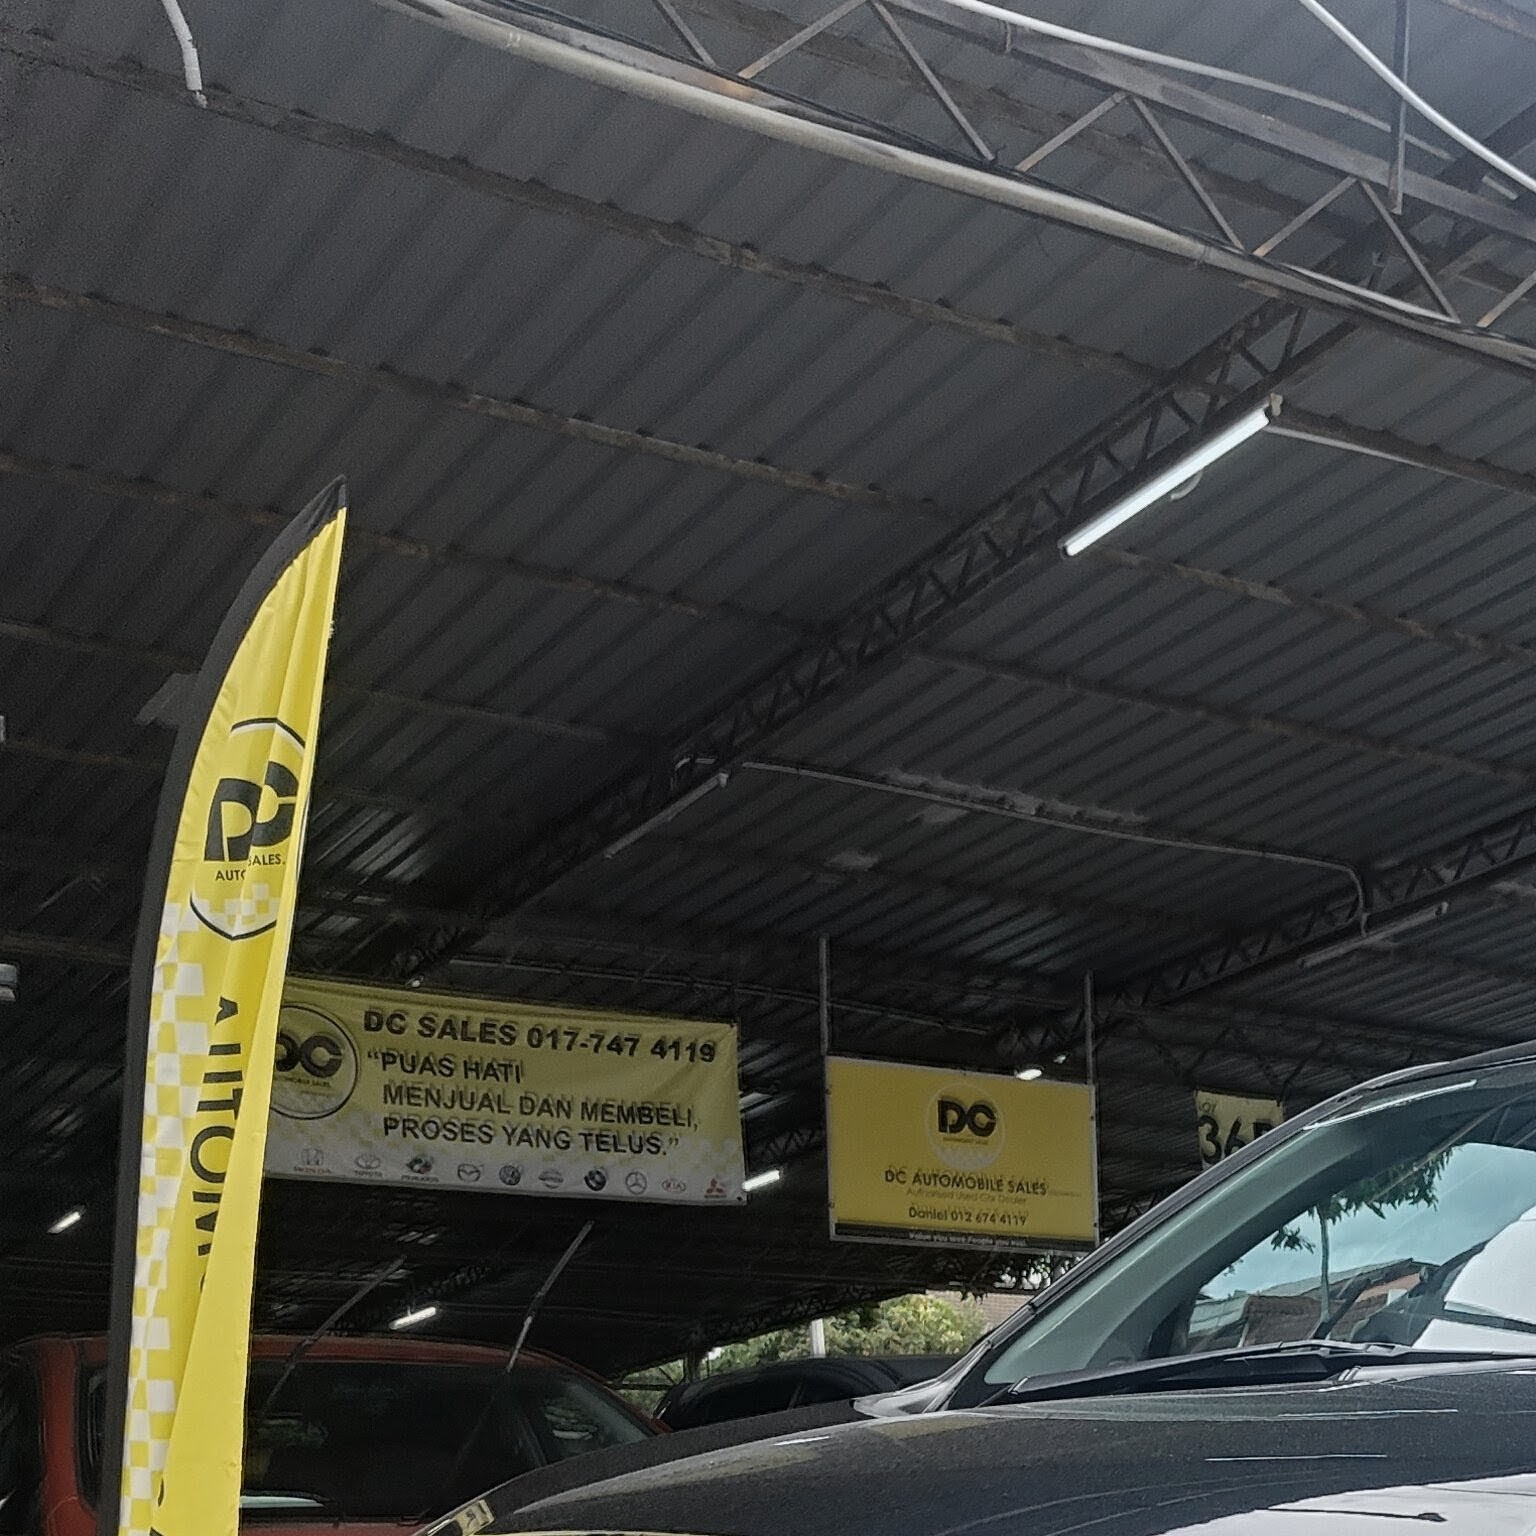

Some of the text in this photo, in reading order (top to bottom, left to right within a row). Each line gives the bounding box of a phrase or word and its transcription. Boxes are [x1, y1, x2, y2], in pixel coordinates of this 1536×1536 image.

[204, 761, 300, 861] DC
[364, 1010, 716, 1063] DC SALES 017-747 4119
[463, 1058, 522, 1084] HATI
[383, 1083, 698, 1132] MENJUAL DAN MEMBELI,
[937, 1099, 997, 1137] DC
[383, 1116, 493, 1145] PROSES
[501, 1124, 572, 1151] YANG
[884, 1169, 907, 1184] DC
[911, 1171, 1004, 1192] AUTOMOBILE
[1007, 1179, 1048, 1196] SALES
[908, 1206, 948, 1221] Daniel
[950, 1208, 973, 1223] 012
